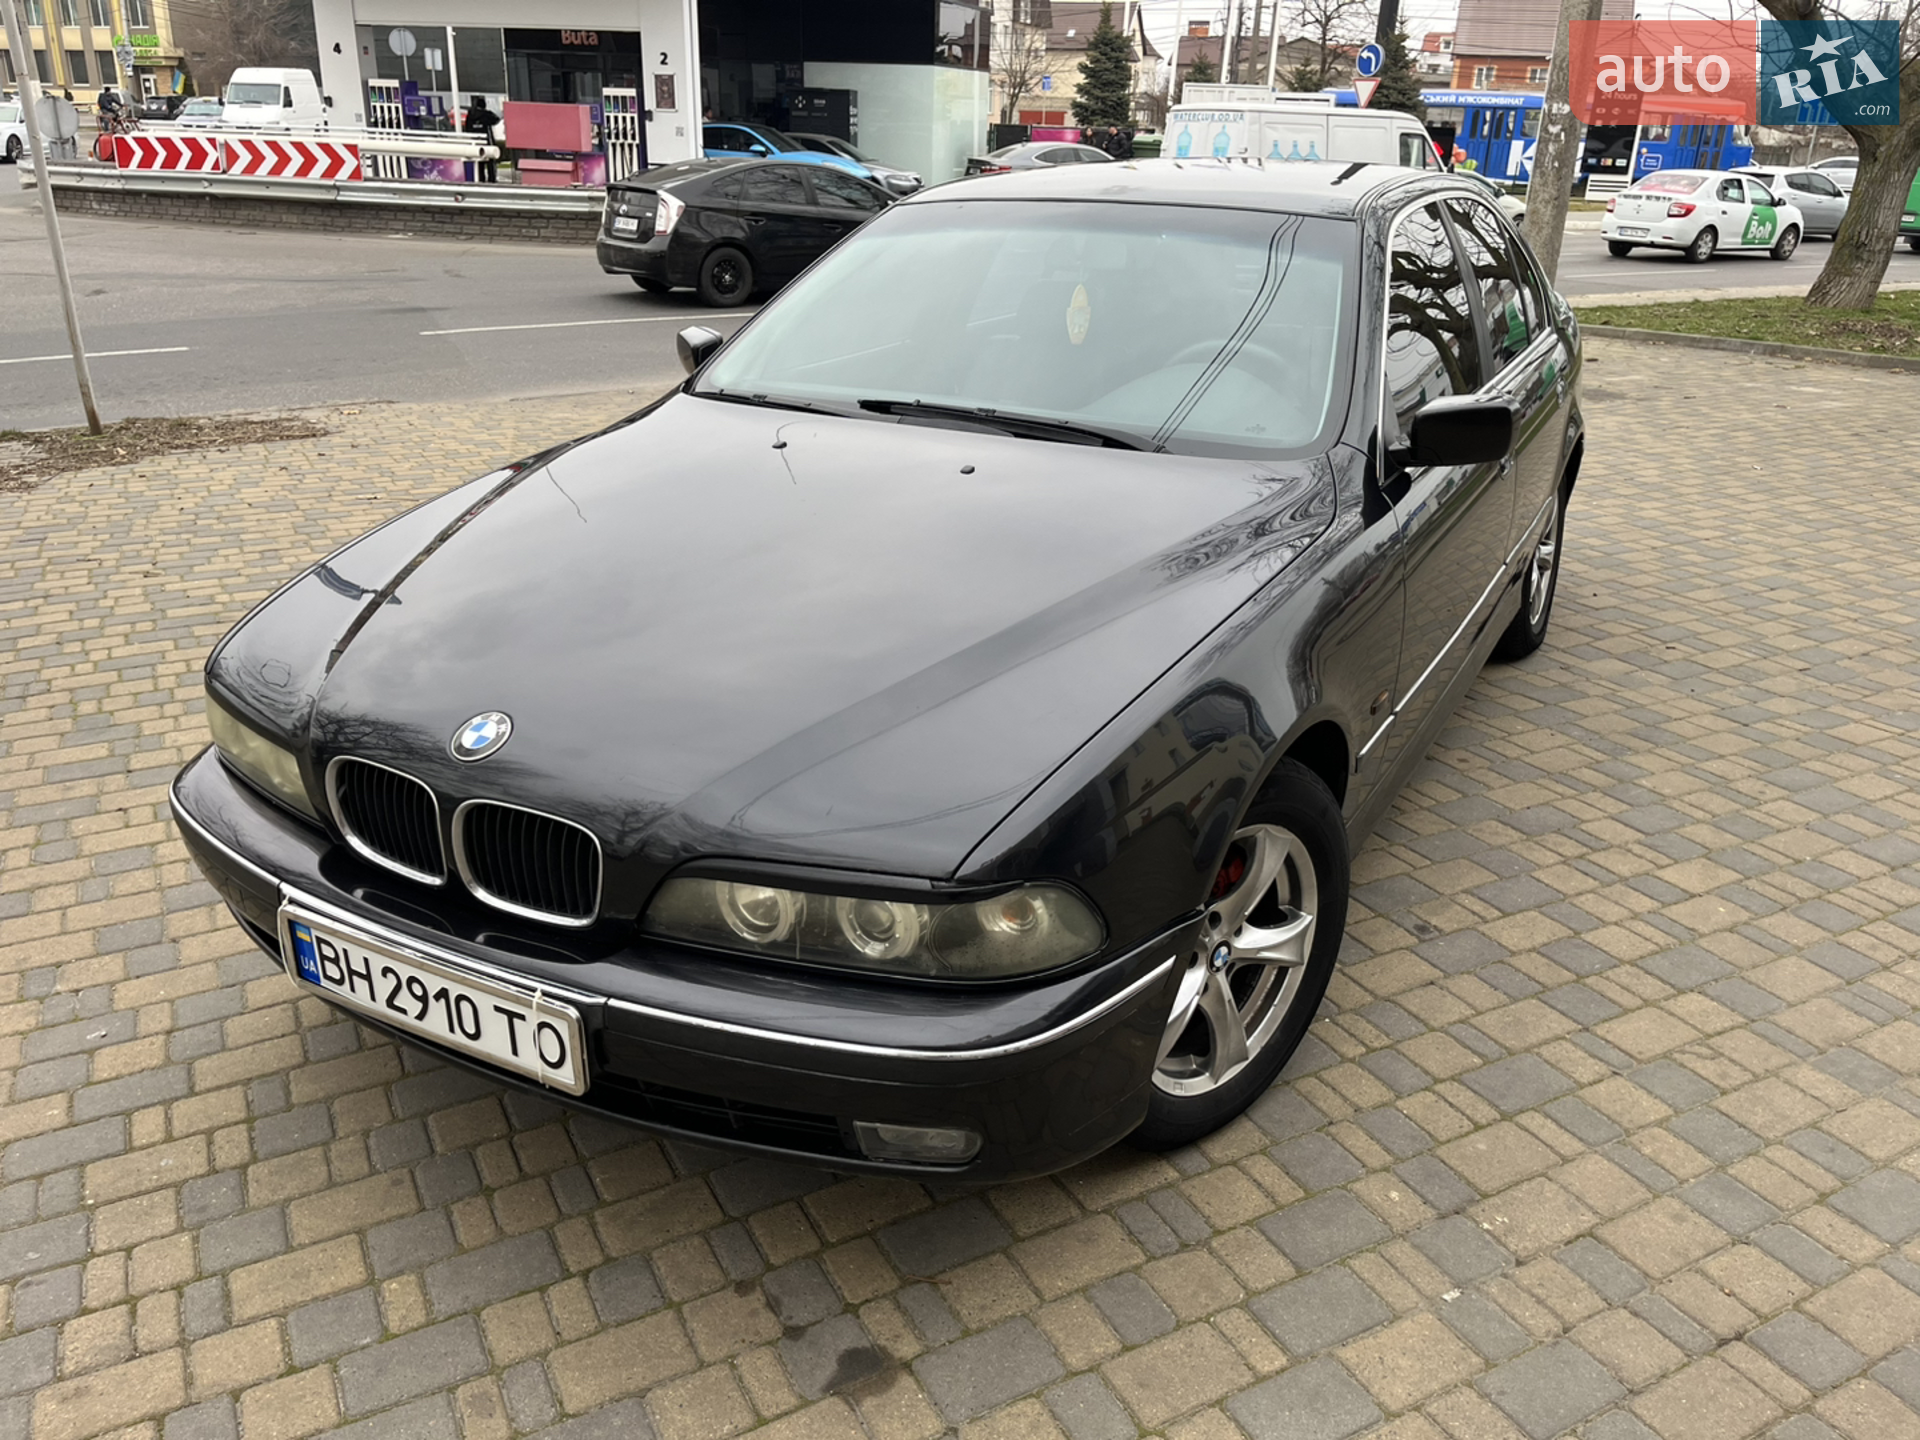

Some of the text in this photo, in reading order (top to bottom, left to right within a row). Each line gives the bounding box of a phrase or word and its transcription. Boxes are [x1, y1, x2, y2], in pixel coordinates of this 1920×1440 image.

[561, 30, 599, 46] Buta
[333, 42, 342, 55] 4
[660, 52, 669, 66] 2
[1614, 92, 1638, 100] hours
[1747, 220, 1772, 243] Bolt
[300, 956, 317, 975] UA
[316, 935, 566, 1070] BH 2910 TO
